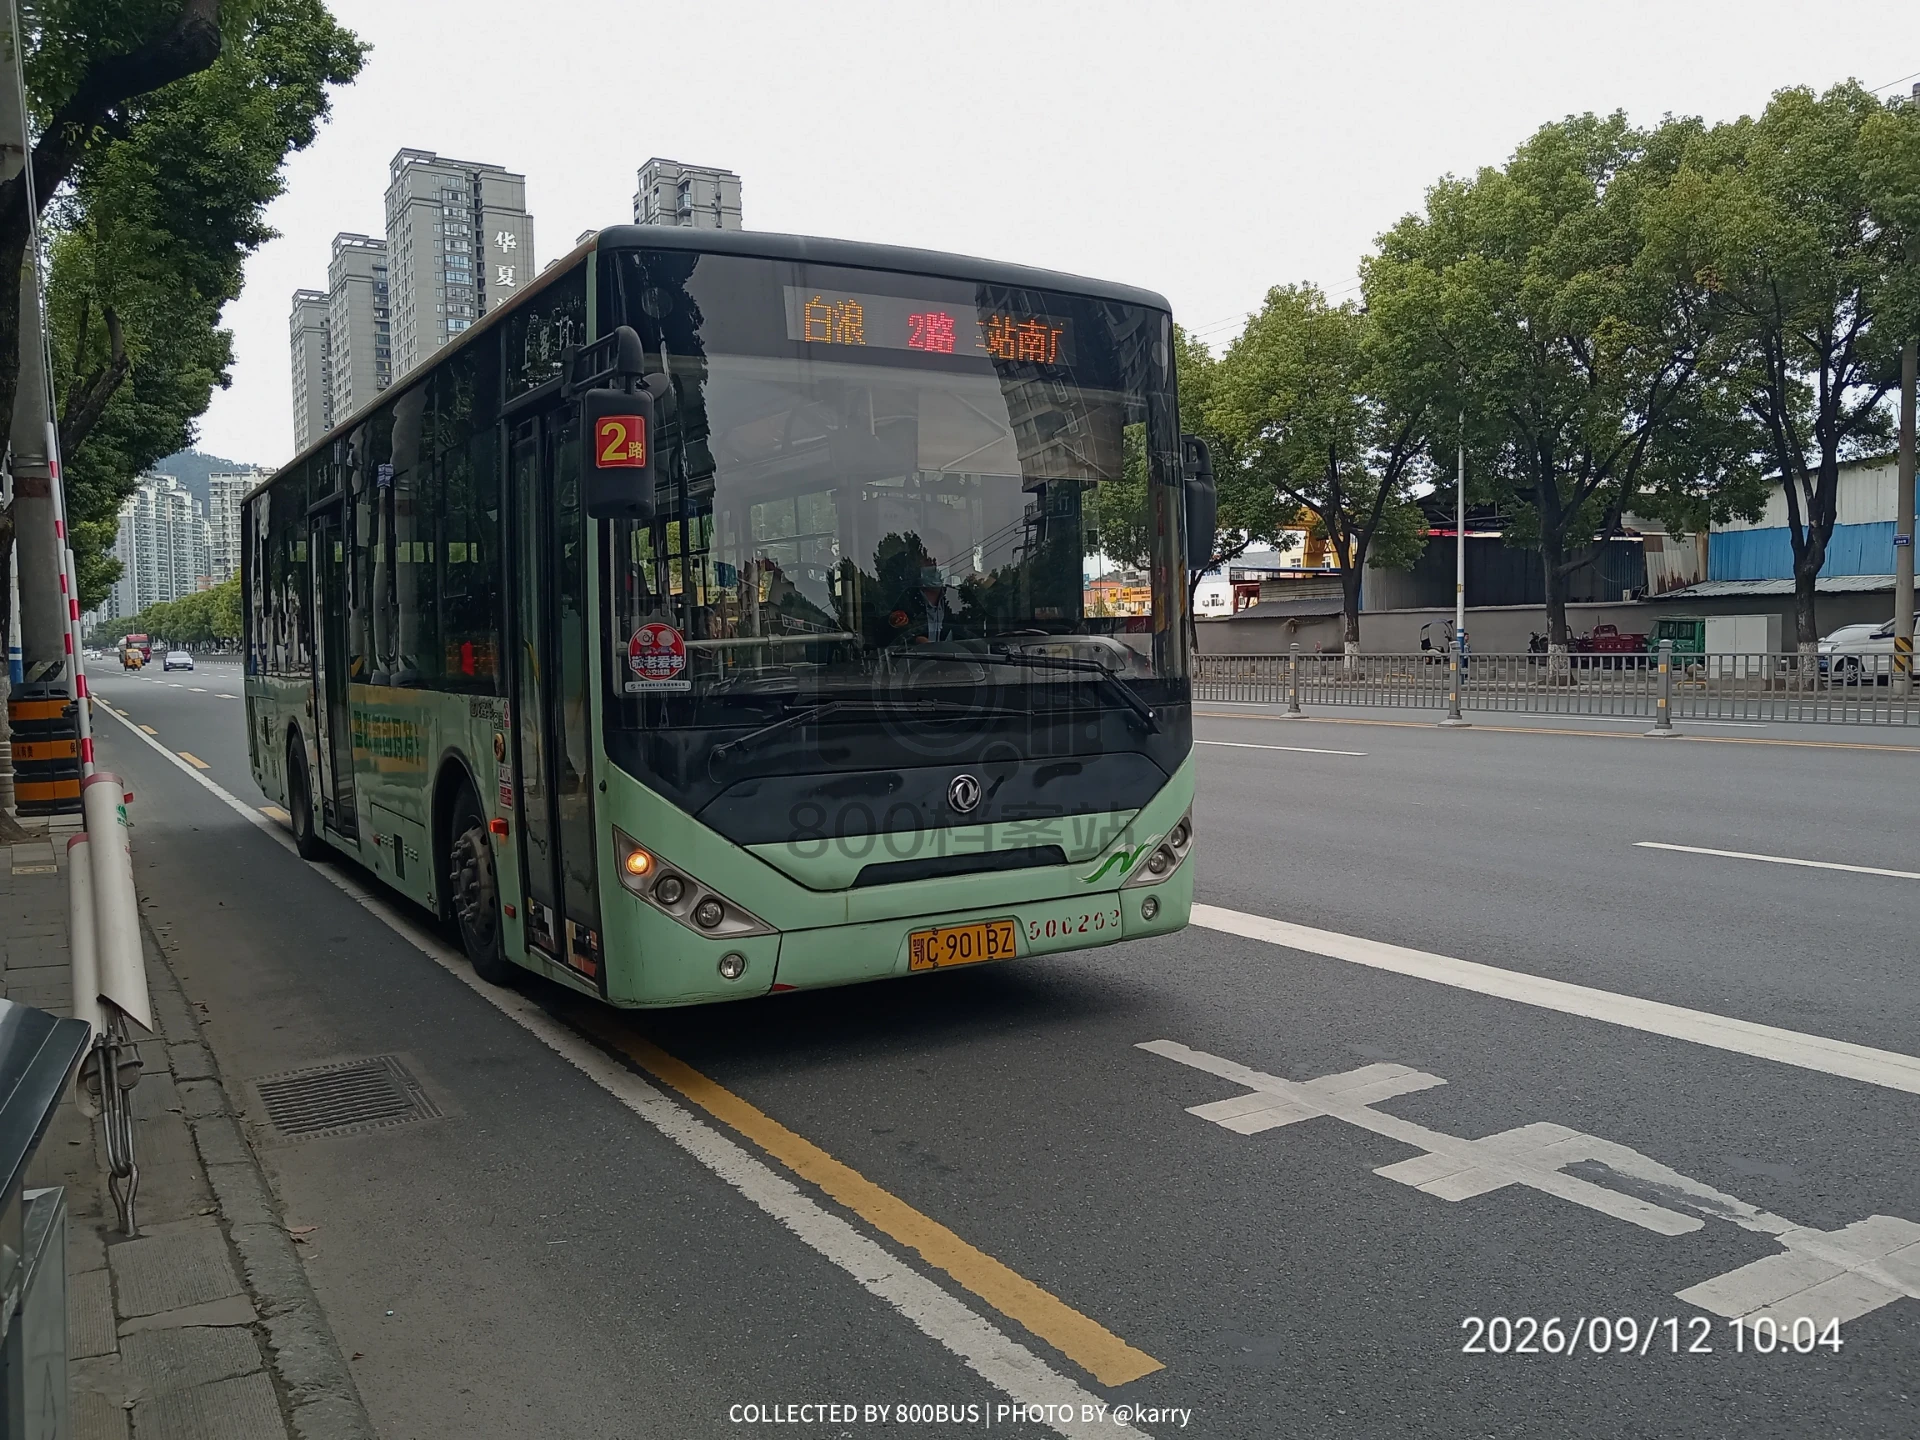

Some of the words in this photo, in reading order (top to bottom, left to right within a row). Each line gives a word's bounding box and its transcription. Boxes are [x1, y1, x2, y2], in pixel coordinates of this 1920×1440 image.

[493, 231, 517, 306] 华夏
[804, 295, 867, 346] 白浪
[907, 312, 956, 354] 2路
[600, 422, 643, 461] 2路
[631, 655, 684, 669] 敬老爱老
